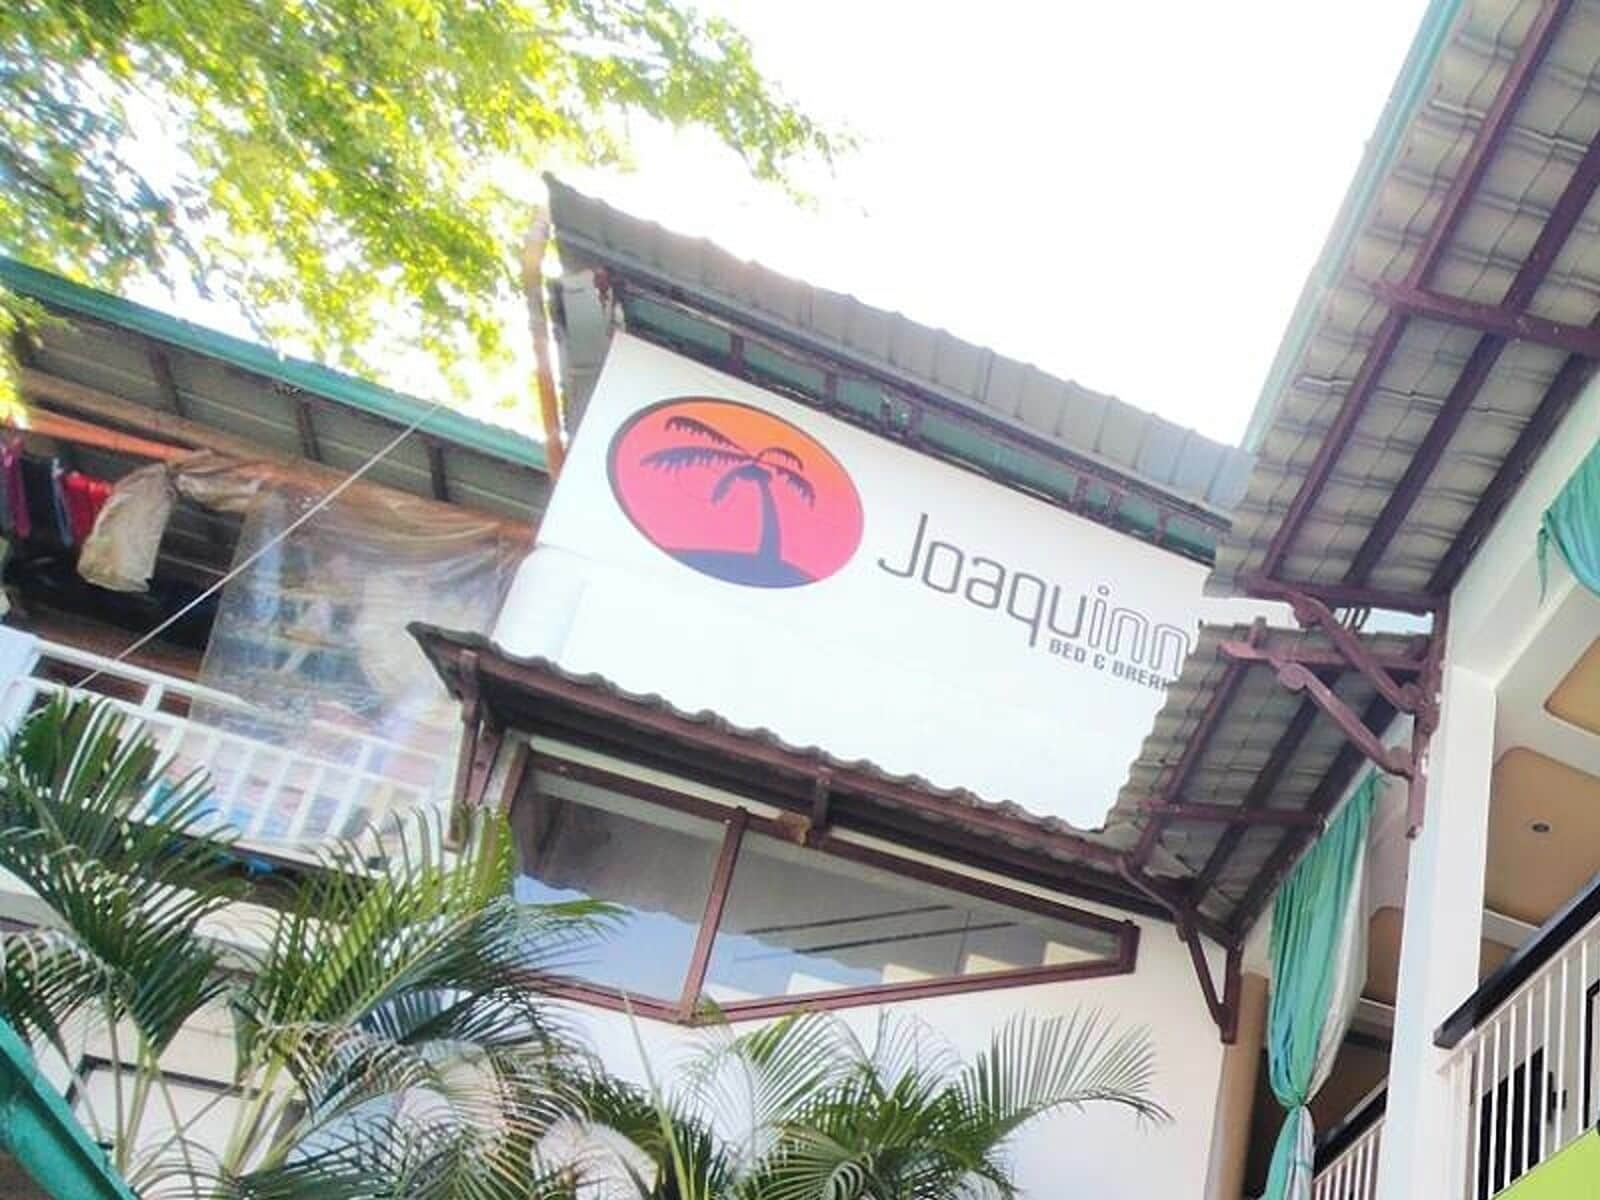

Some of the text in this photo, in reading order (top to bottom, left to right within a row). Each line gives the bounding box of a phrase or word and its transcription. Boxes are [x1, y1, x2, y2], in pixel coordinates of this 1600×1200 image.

[877, 512, 1191, 677] Joaquinn
[1049, 638, 1087, 664] BED
[1092, 653, 1106, 671] &
